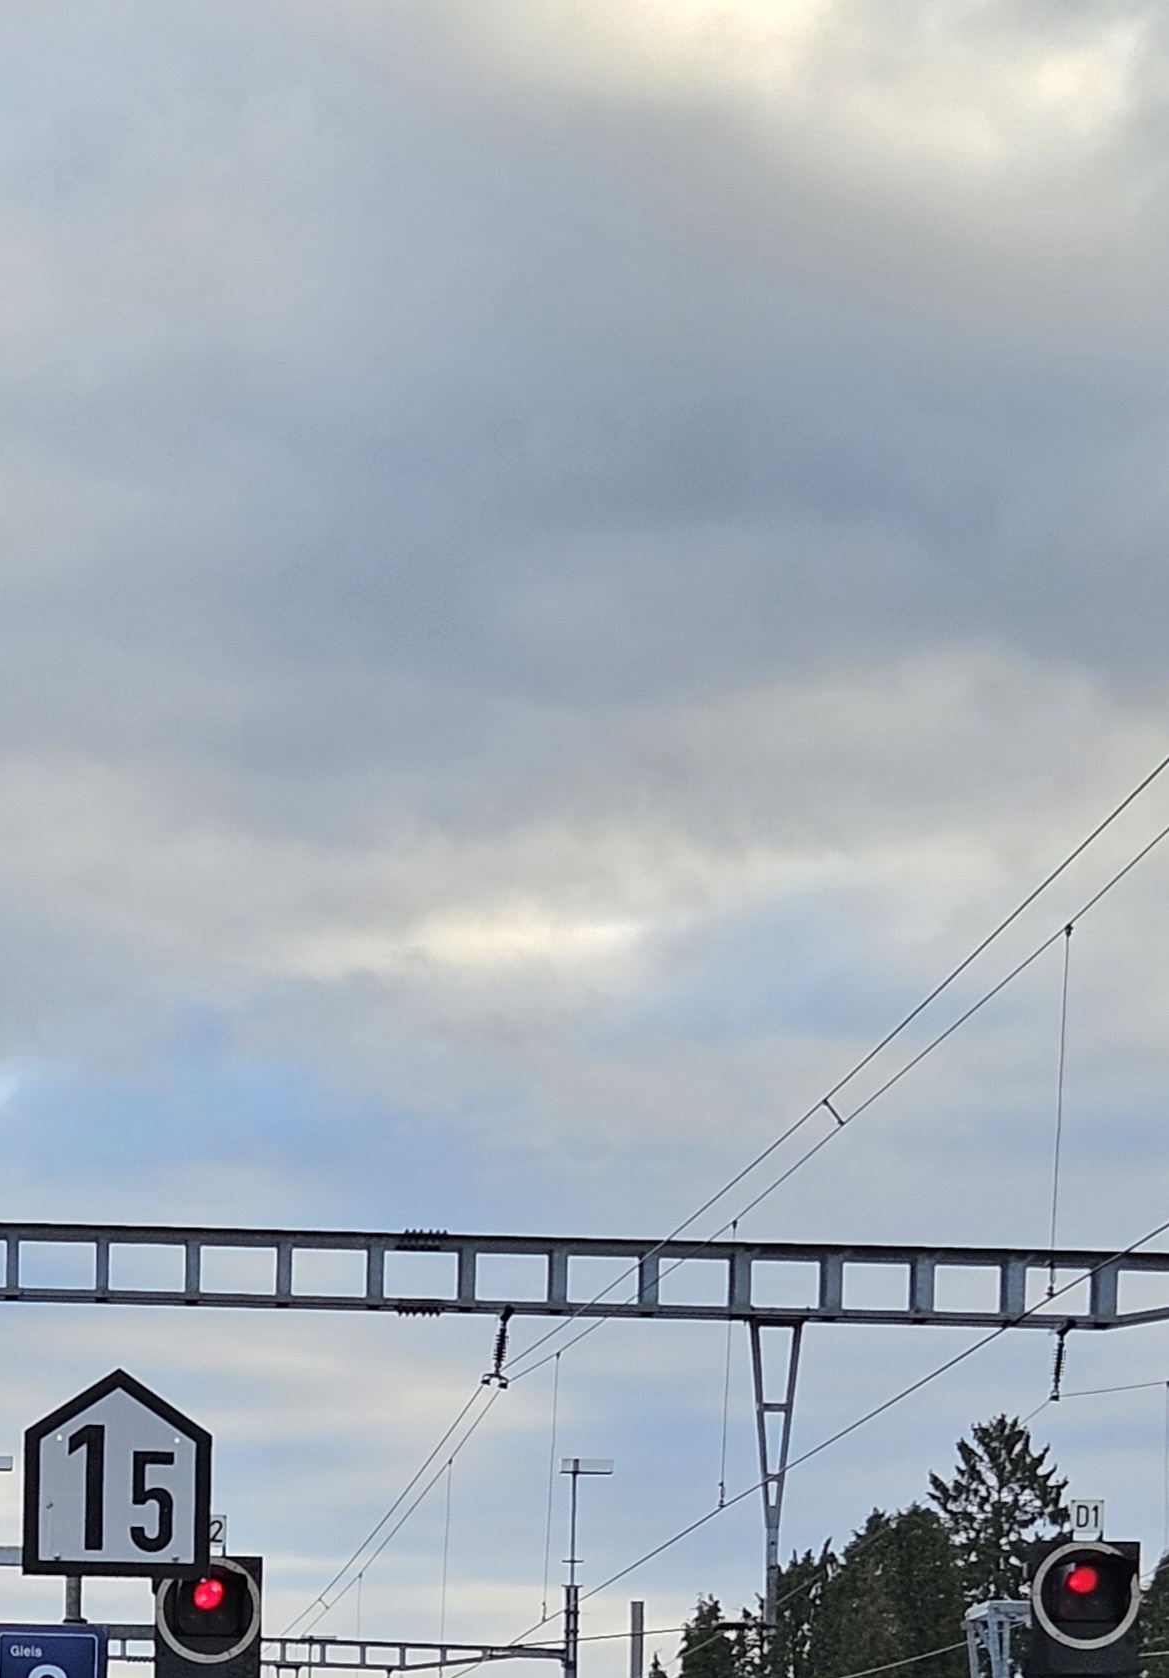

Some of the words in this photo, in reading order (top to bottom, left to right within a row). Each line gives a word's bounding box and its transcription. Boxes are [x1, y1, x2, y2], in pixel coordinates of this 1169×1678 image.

[68, 1424, 175, 1552] 15
[1076, 1504, 1099, 1528] D1
[10, 1645, 42, 1658] Gleis
